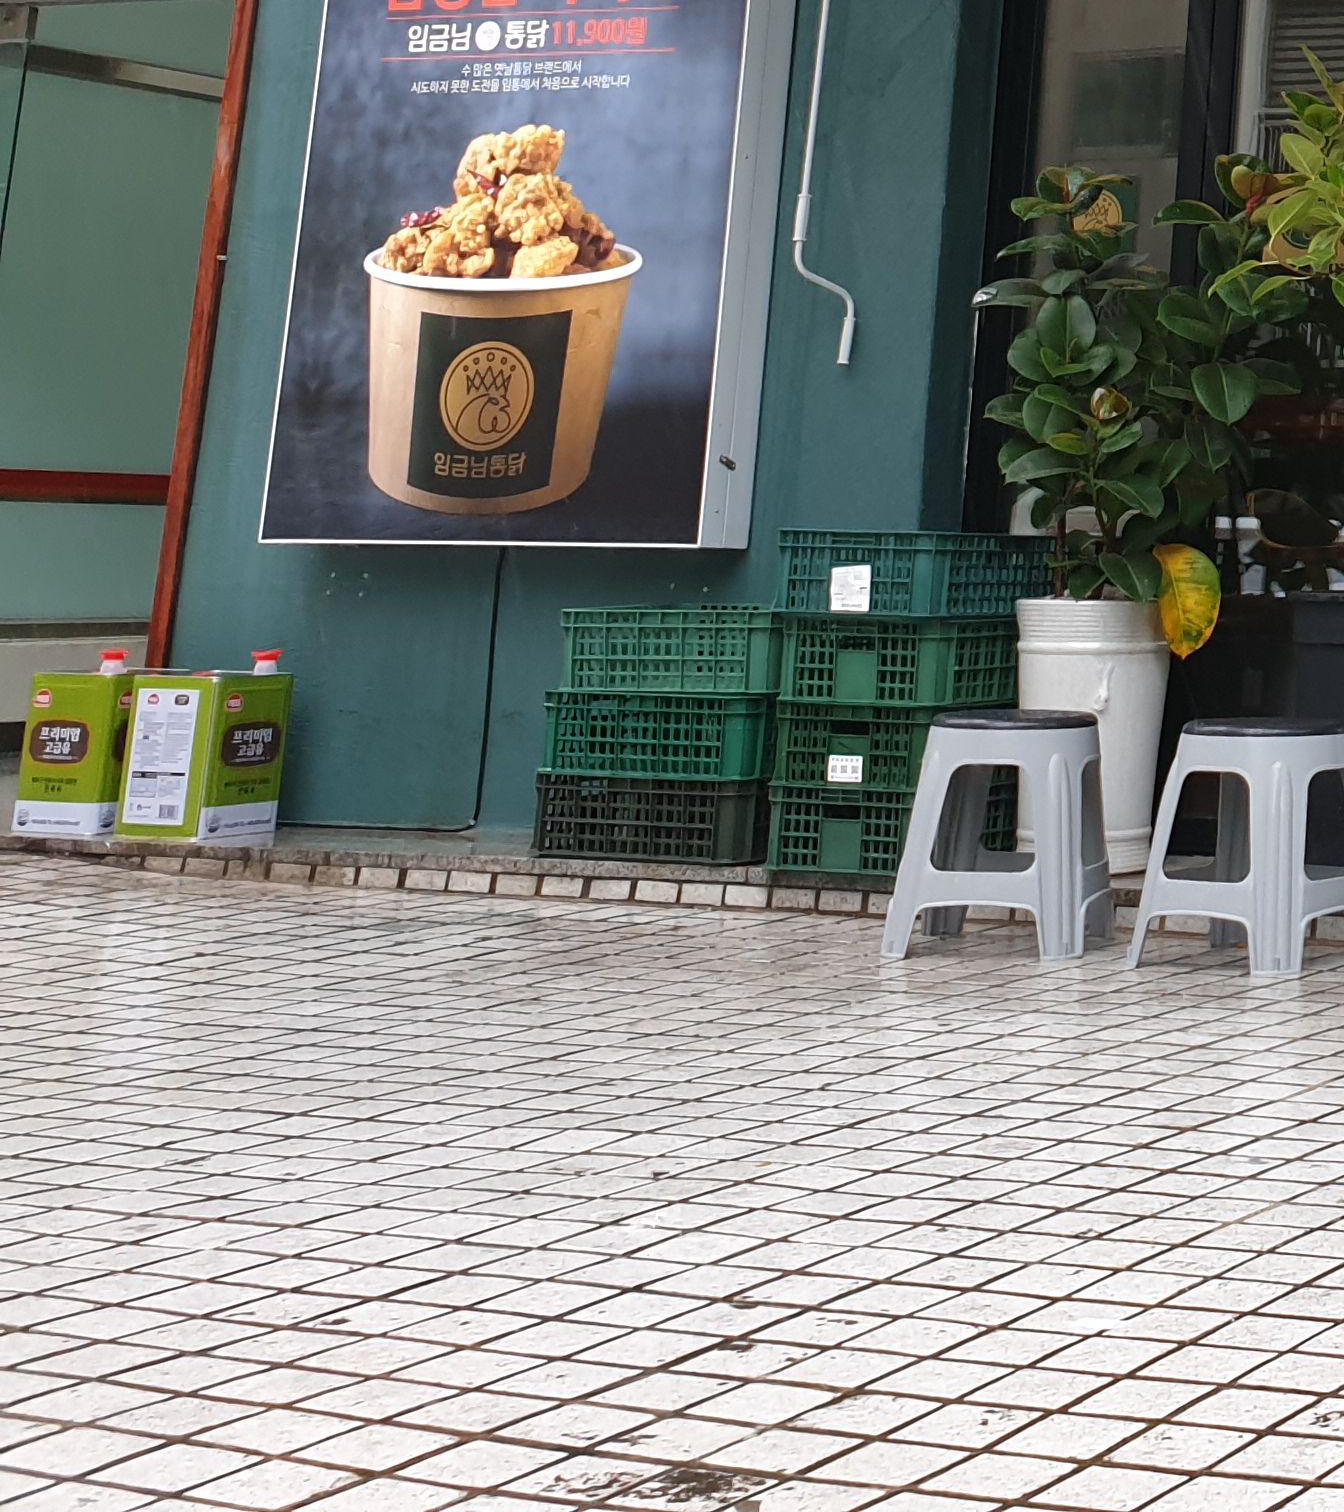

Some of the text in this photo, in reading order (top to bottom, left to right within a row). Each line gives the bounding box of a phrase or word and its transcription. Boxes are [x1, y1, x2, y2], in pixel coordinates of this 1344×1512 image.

[407, 17, 648, 53] 임금님 통닭 11,900원
[434, 452, 527, 478] 임금님통닭
[39, 727, 80, 742] 프리미엄
[232, 728, 273, 744] 프리미엄
